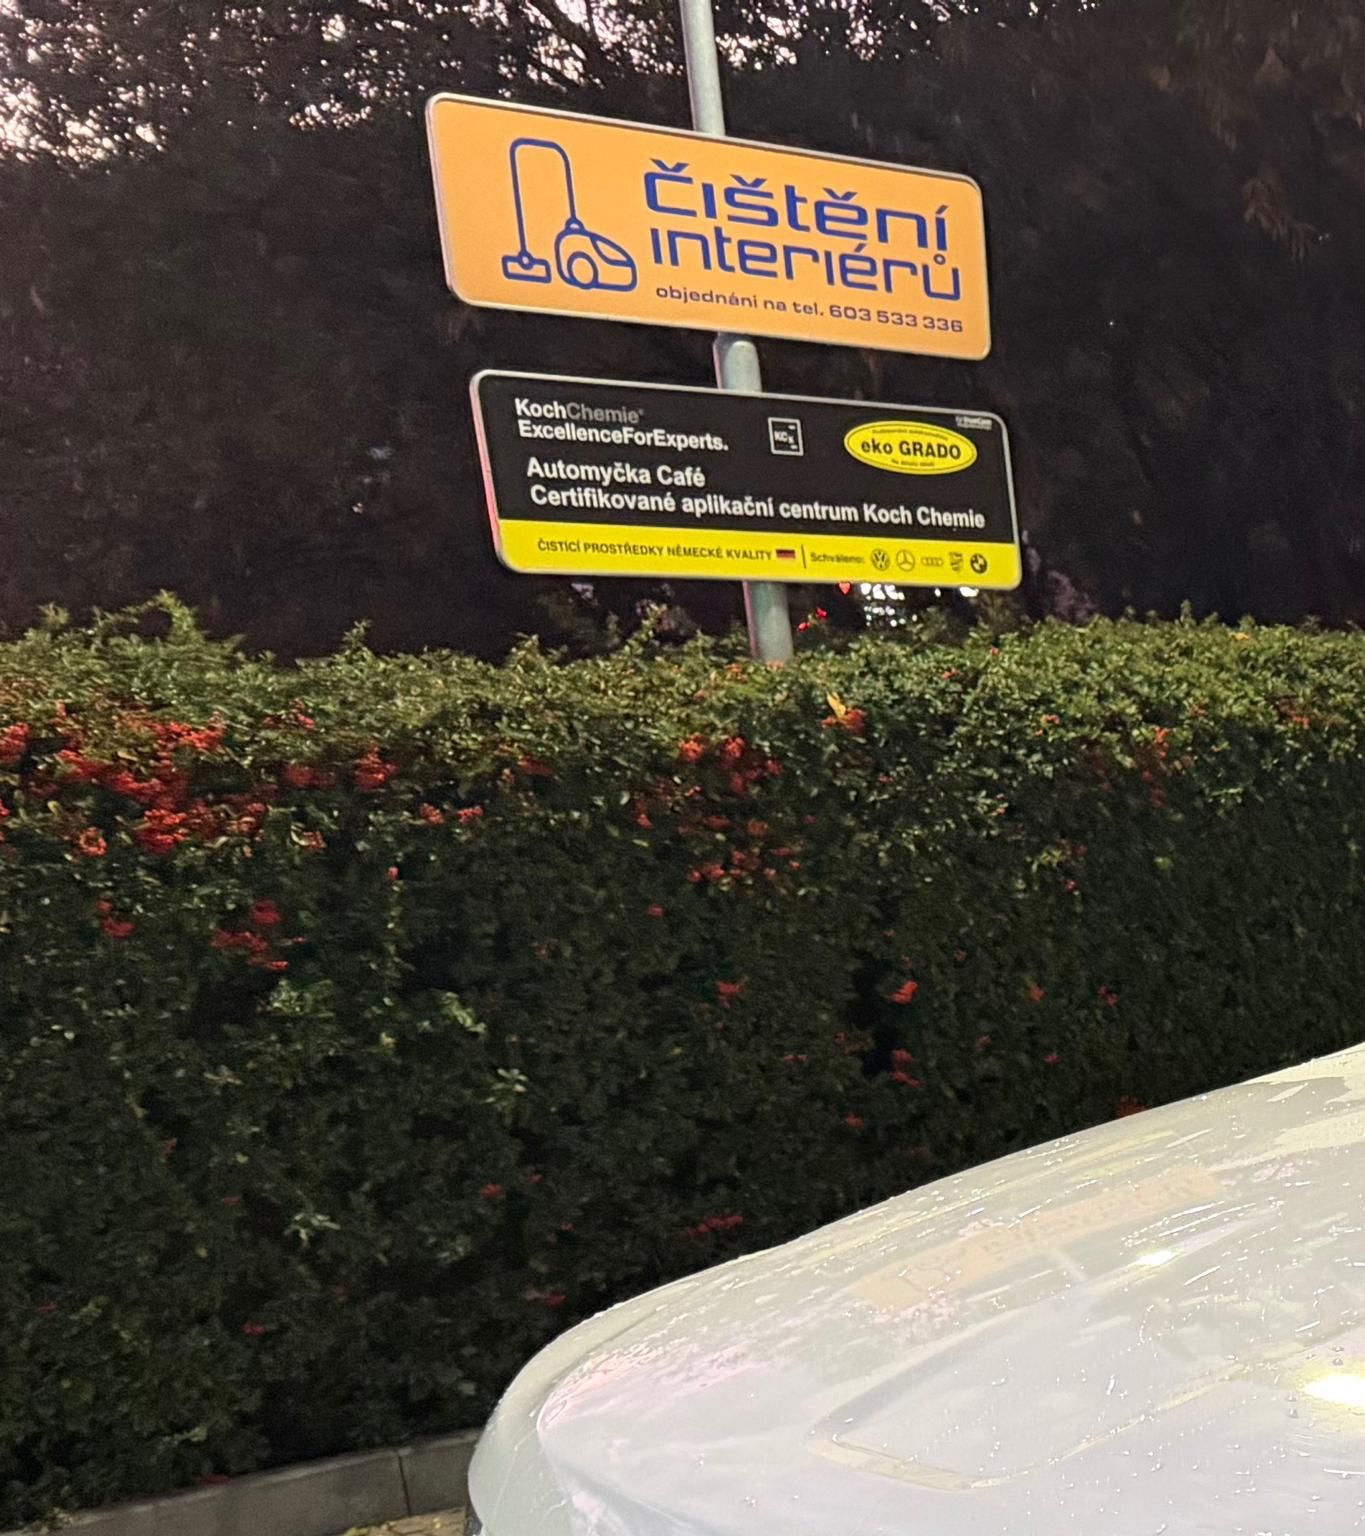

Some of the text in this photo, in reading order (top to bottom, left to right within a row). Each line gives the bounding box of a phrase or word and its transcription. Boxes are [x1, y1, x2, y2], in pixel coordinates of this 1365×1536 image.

[643, 158, 949, 251] Čištění
[763, 299, 787, 312] na
[793, 299, 824, 317] tel.
[829, 304, 872, 322] 603
[877, 310, 918, 328] 533
[923, 316, 964, 333] 336
[517, 419, 729, 451] ExcellenceForExperts.
[861, 437, 962, 460] eko GRADO
[526, 456, 706, 487] Automyčka Café
[530, 483, 986, 529] Certifikované aplikační centrum Koch Chemie
[537, 537, 773, 561] ČISTÍCÍ PROSTŘEDKY NĚMECKÉ KVALITY
